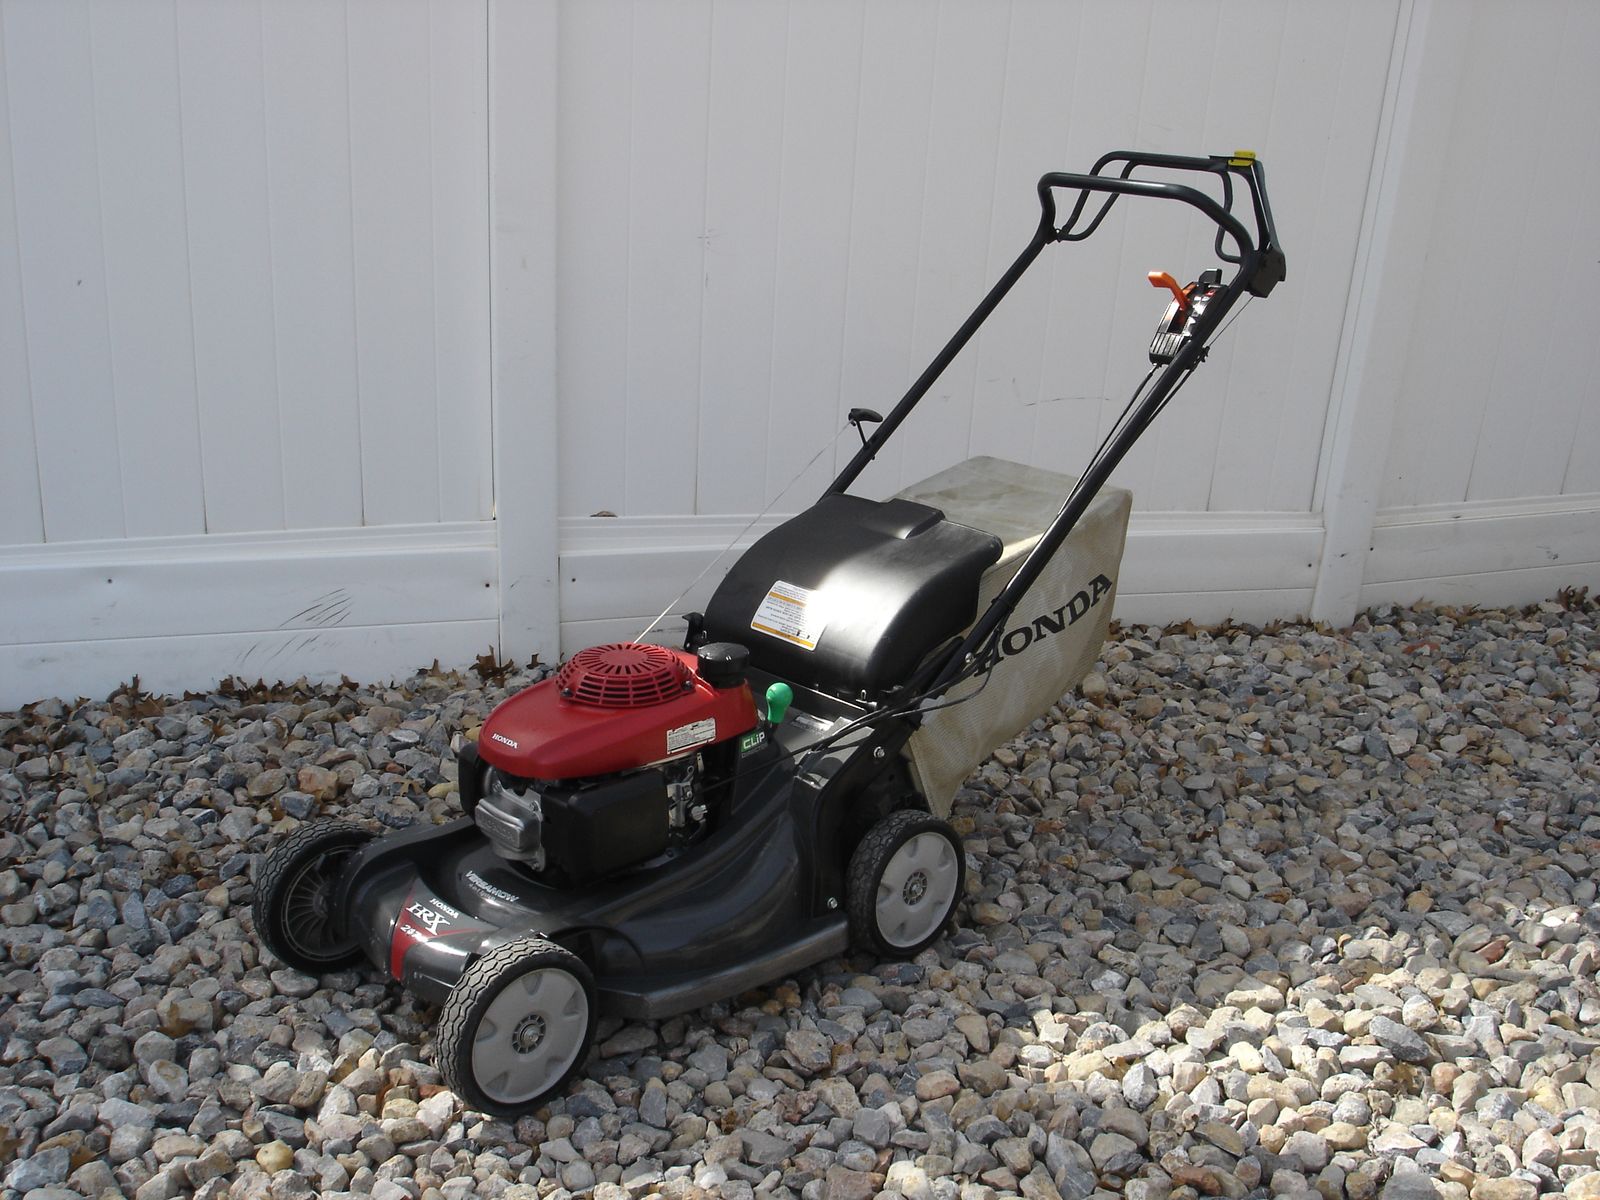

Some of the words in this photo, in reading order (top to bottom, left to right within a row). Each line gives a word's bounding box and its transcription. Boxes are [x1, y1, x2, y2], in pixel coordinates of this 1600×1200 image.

[491, 732, 518, 749] HONDA
[465, 870, 520, 902] VERSAMOW
[406, 902, 450, 936] HRX
[429, 898, 459, 919] HONDA
